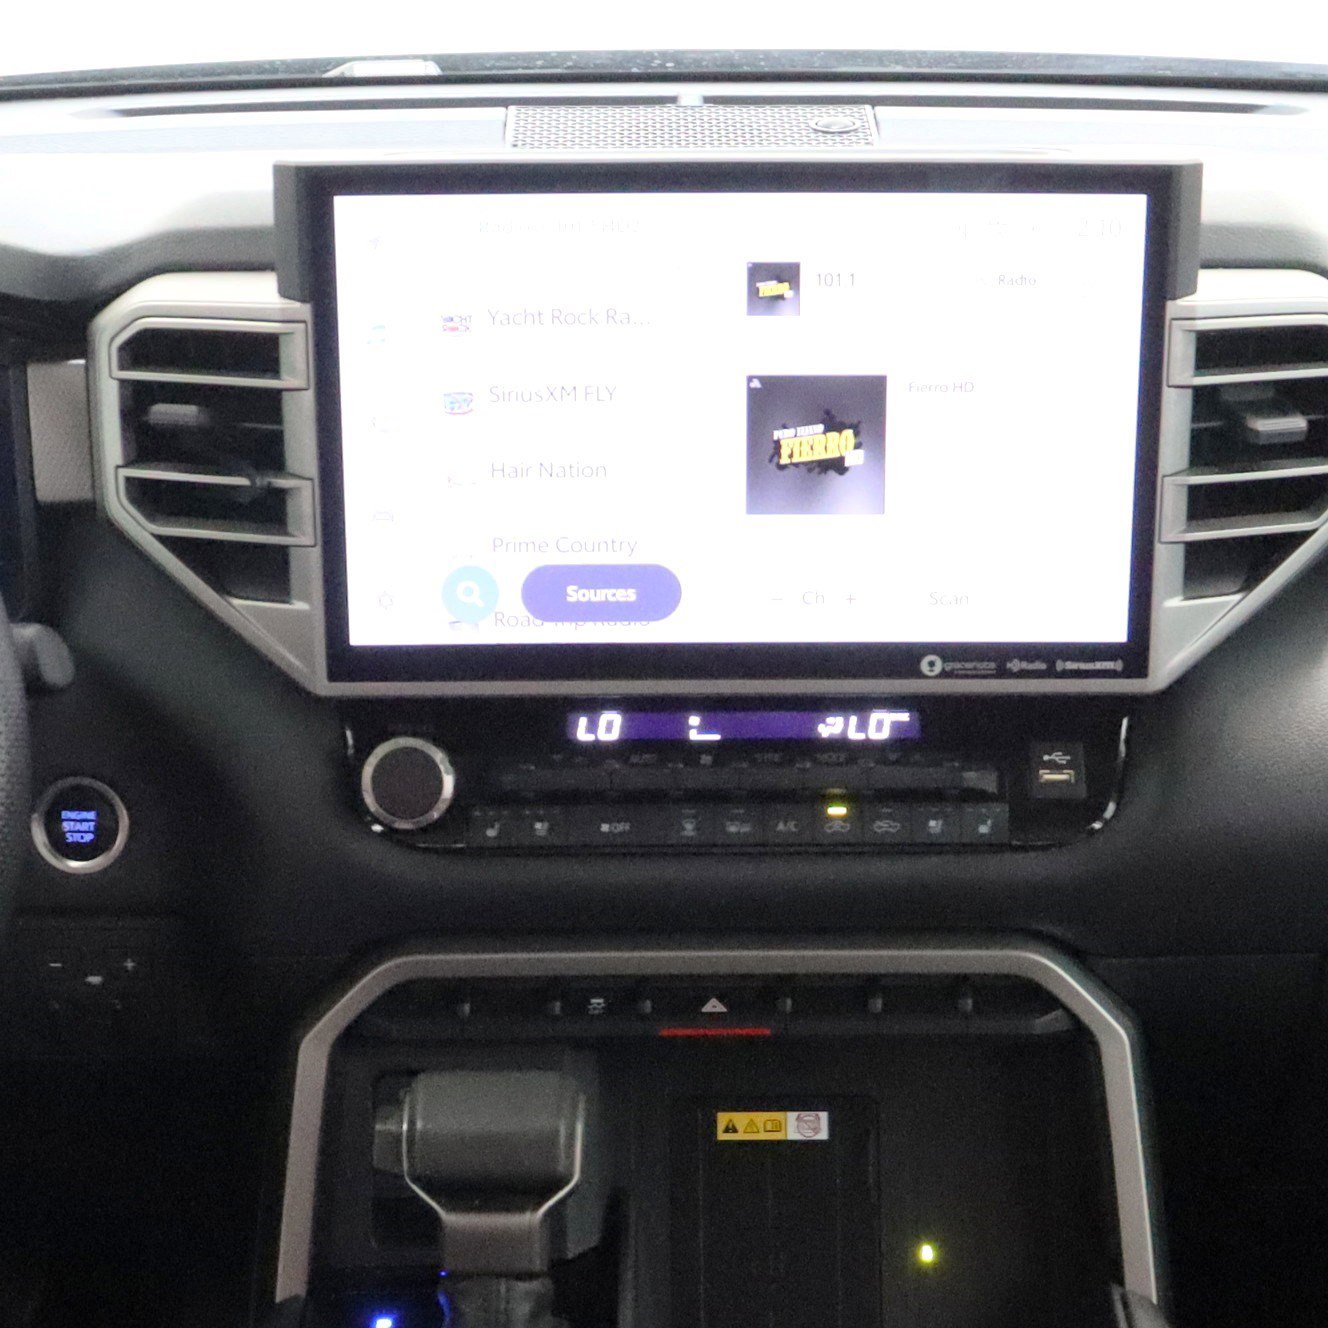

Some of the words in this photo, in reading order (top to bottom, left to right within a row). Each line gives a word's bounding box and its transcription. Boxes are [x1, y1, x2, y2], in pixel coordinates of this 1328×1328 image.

[998, 274, 1036, 287] Radio
[487, 307, 544, 326] Yacht
[551, 307, 598, 326] Rock
[489, 384, 578, 403] SiriusXM
[583, 384, 618, 403] FLY
[908, 380, 949, 394] Fierro
[953, 380, 975, 393] HD
[490, 461, 532, 480] Hair
[538, 461, 608, 480] Nation
[492, 537, 549, 554] Prime
[556, 536, 638, 558] Country
[566, 585, 637, 602] Sources
[802, 590, 825, 605] Ch
[928, 591, 970, 606] Scan
[62, 821, 96, 832] START
[65, 832, 95, 843] STOP
